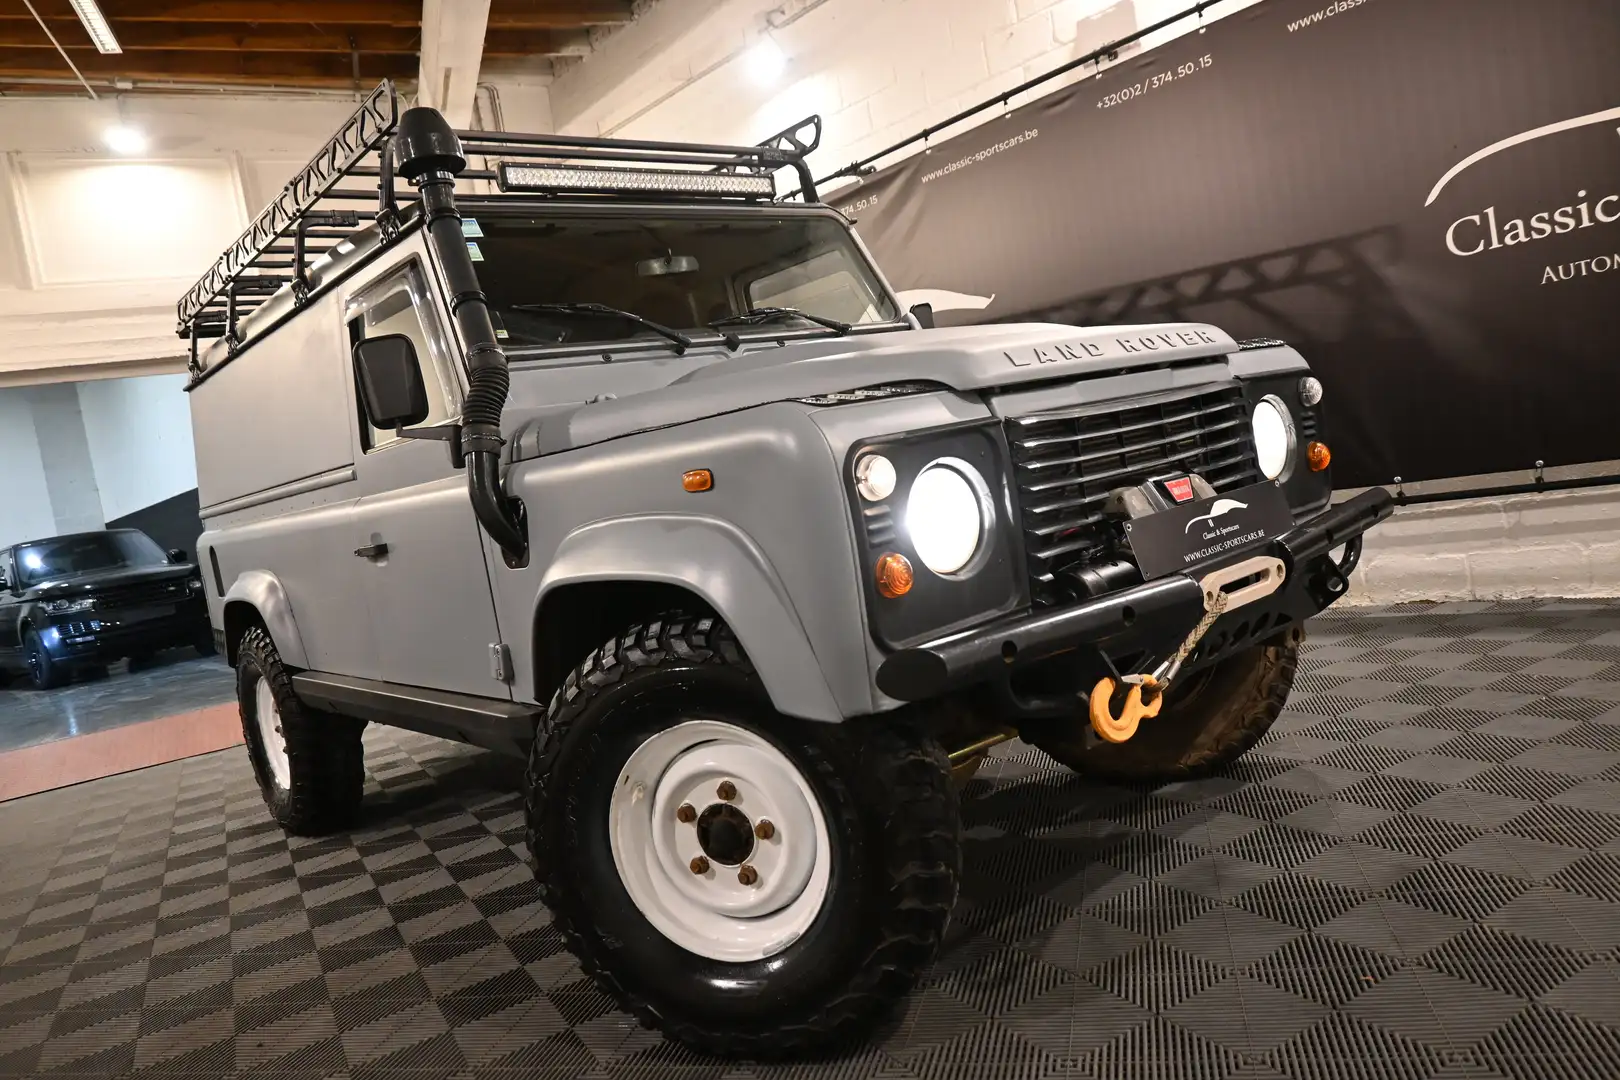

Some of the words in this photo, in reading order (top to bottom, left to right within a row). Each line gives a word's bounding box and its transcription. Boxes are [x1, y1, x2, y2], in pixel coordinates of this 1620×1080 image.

[1287, 0, 1367, 33] www.class
[1096, 84, 1142, 109] +32(0)2
[1151, 54, 1213, 89] 374.50.15
[921, 127, 1039, 184] www.classic-sportscars.be
[1445, 189, 1620, 257] Classic
[1003, 342, 1104, 367] LAND
[1116, 330, 1216, 352] ROVER
[1183, 529, 1266, 563] WWW.CLASSIC-SPORTSCARS.BE
[1202, 530, 1217, 540] Classic
[1220, 524, 1240, 536] Sportscars
